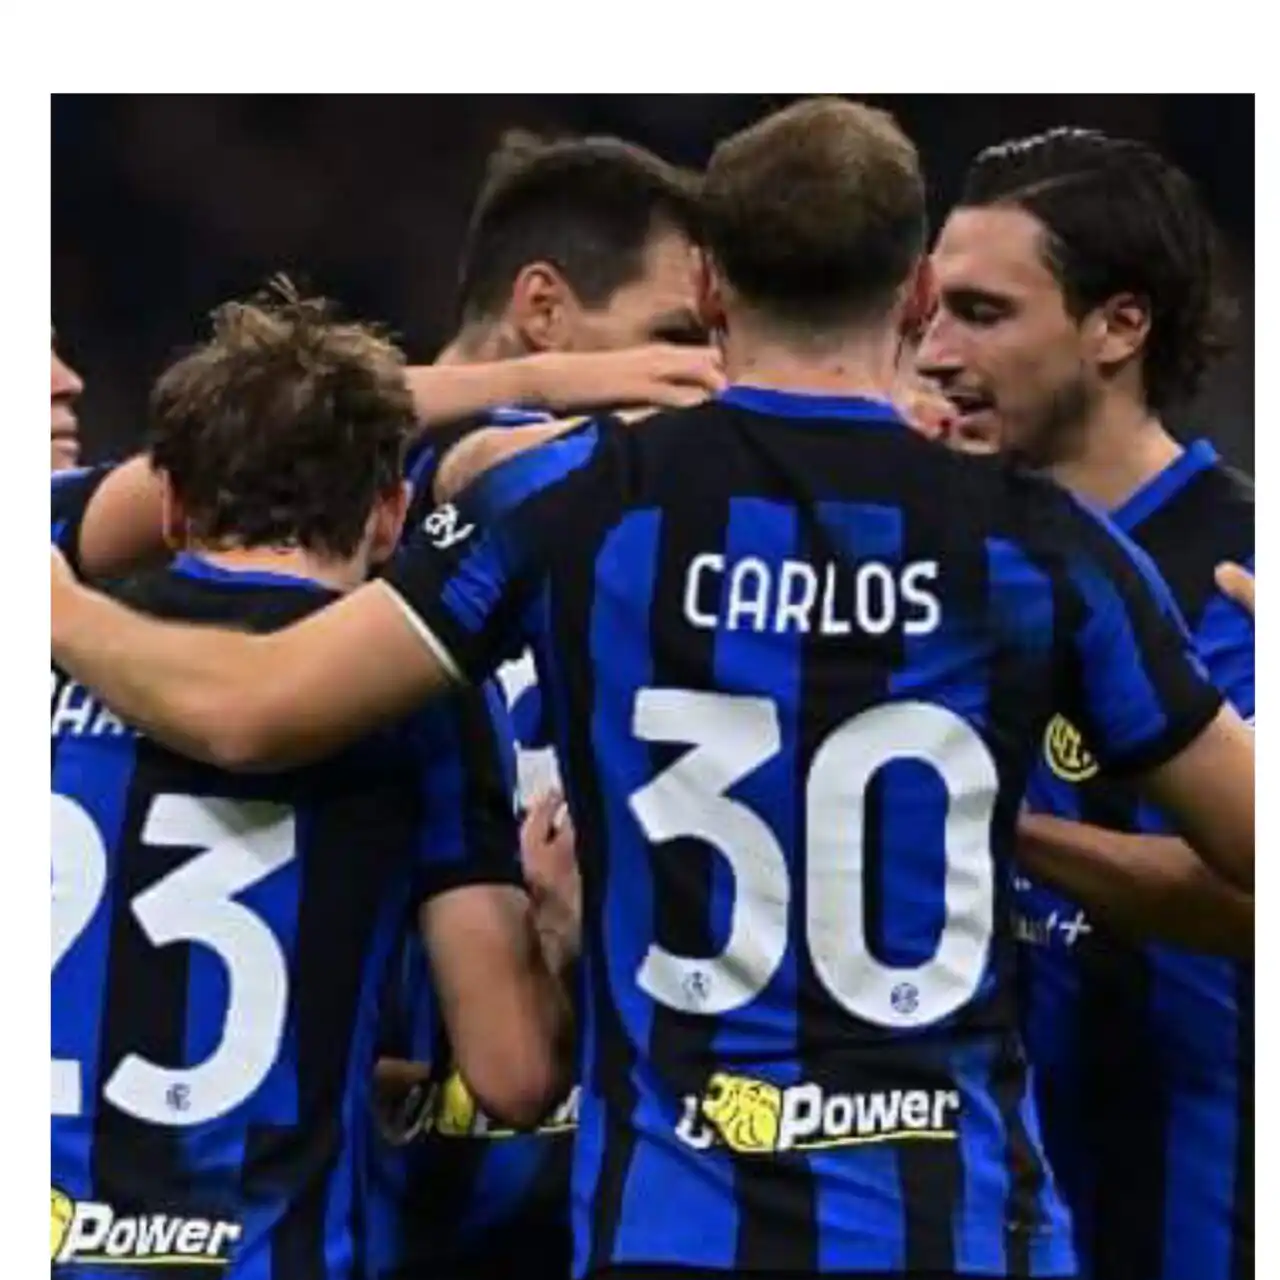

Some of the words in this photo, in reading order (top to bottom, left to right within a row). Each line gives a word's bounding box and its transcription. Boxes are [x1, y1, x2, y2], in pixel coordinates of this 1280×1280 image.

[684, 554, 941, 635] CARLOS
[628, 687, 1000, 1028] 30
[776, 1081, 960, 1151] Power
[56, 1201, 242, 1263] Power
